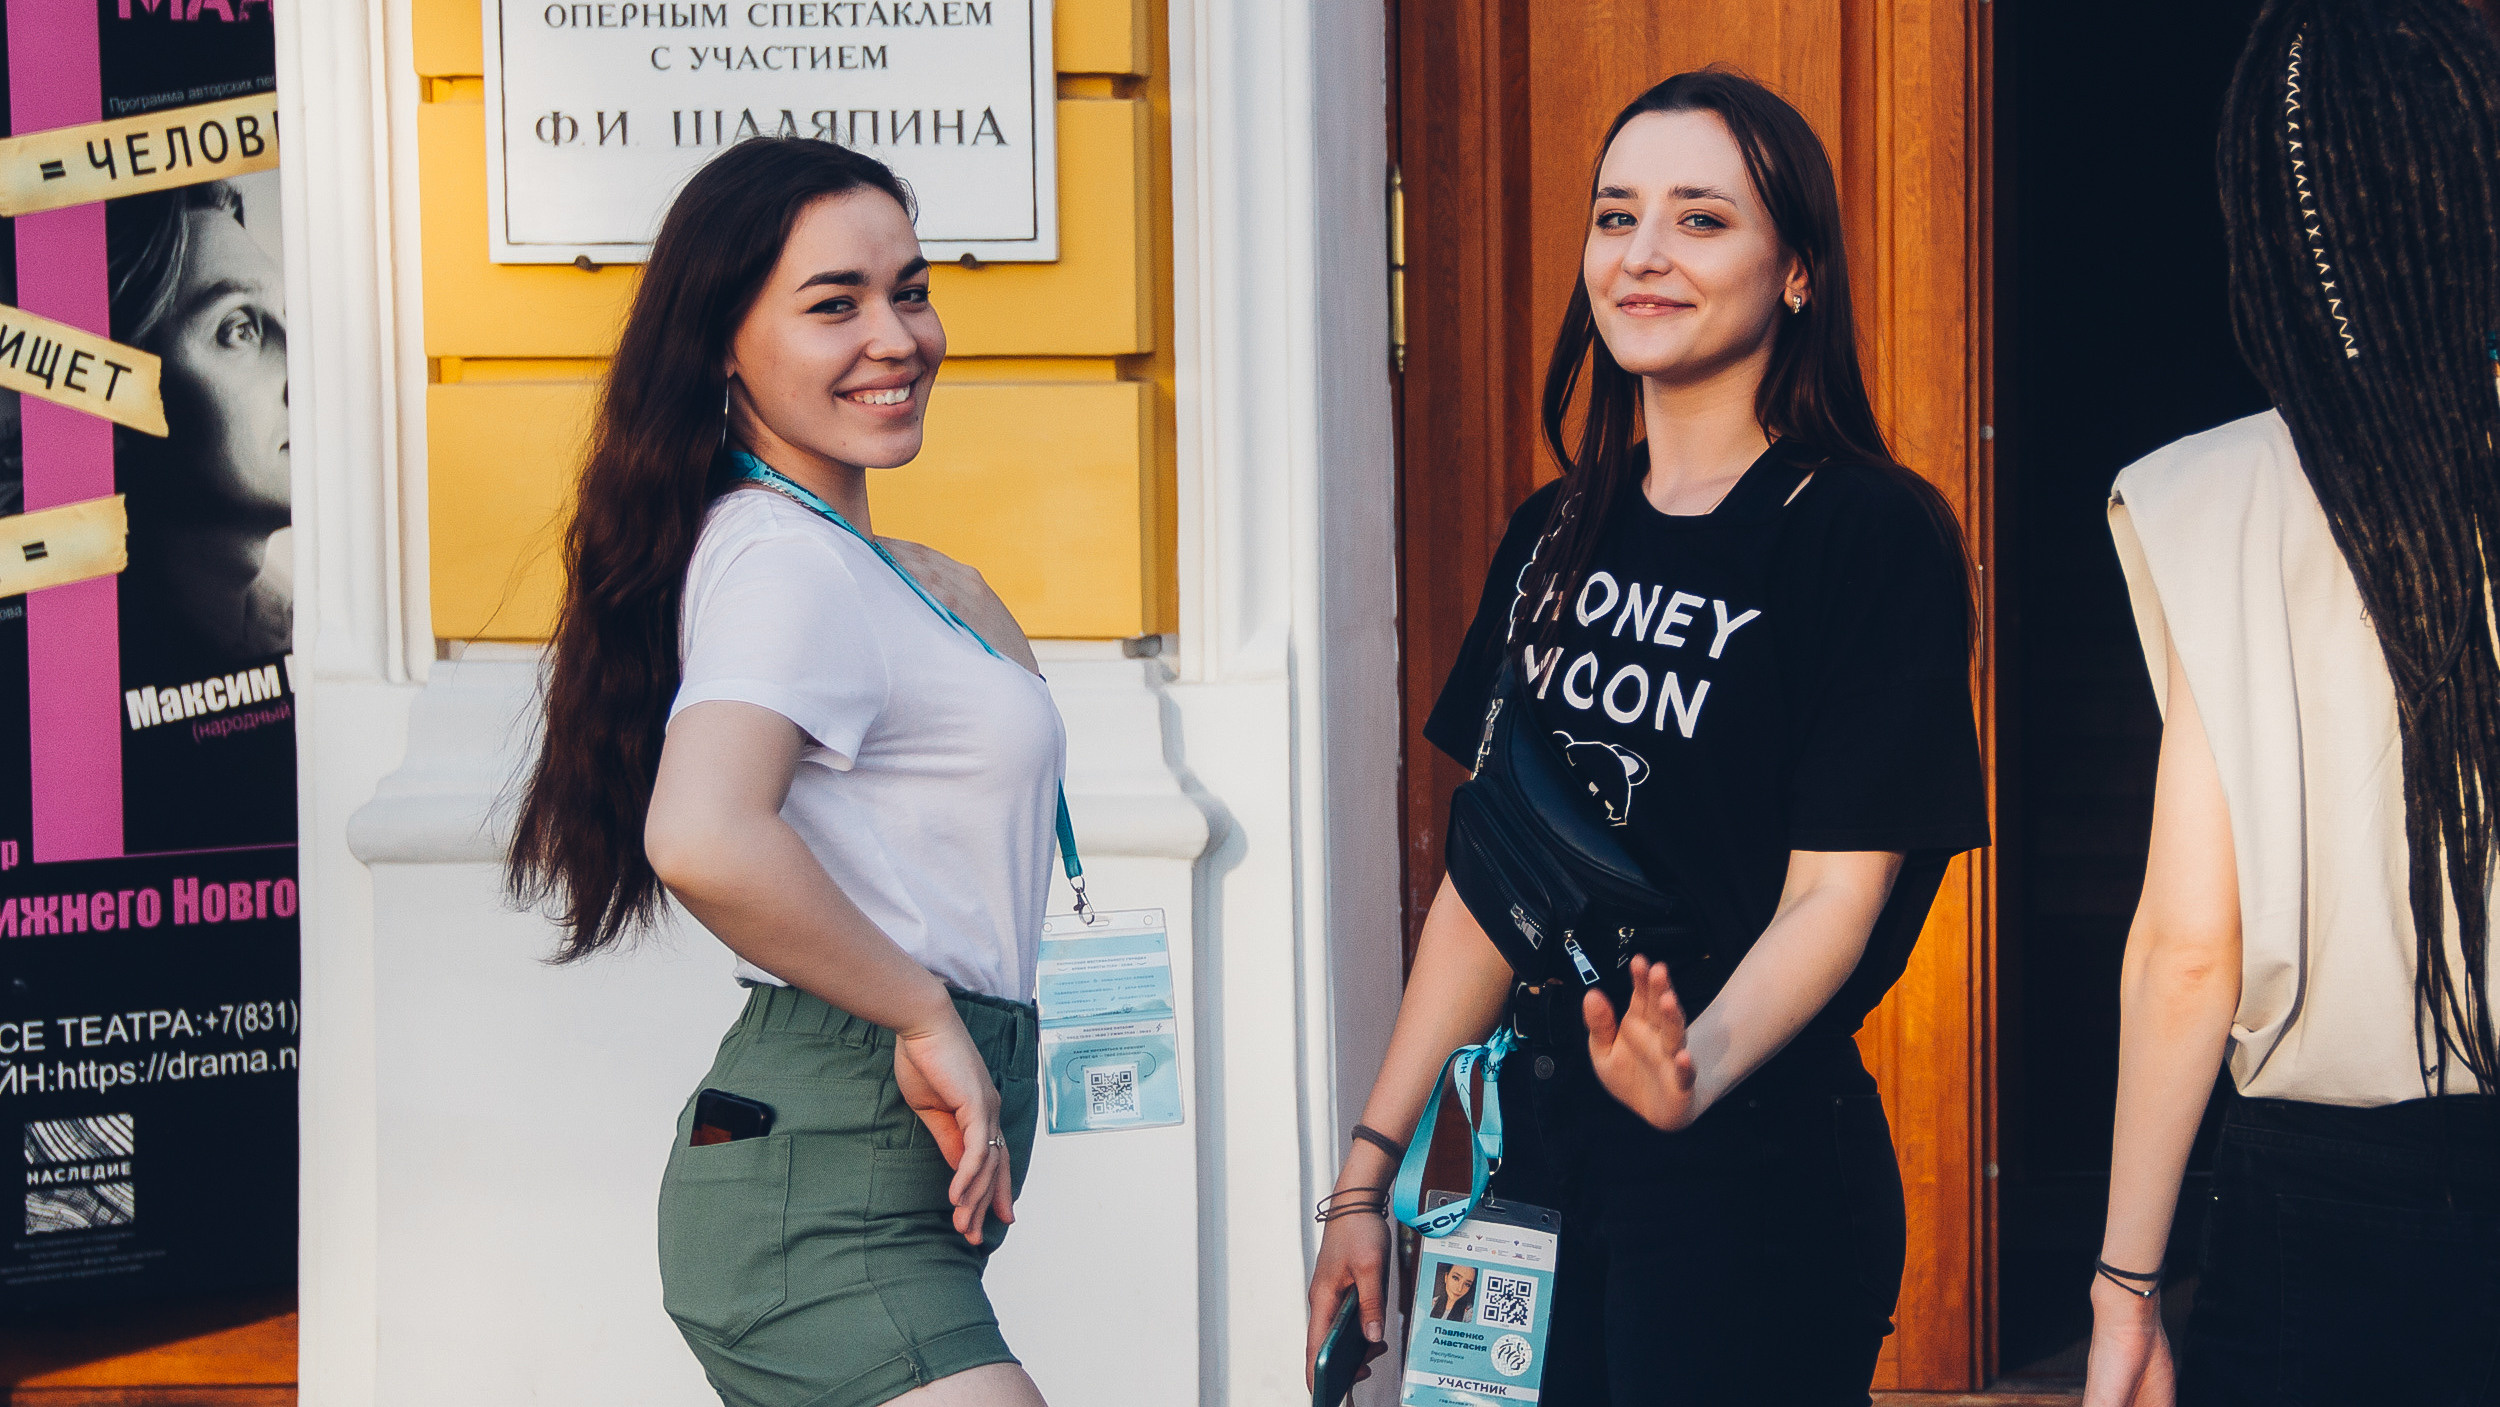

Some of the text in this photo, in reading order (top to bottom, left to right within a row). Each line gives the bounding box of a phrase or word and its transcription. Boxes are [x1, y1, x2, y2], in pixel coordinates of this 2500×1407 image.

[544, 1, 994, 28] ОПЕРНЫМ СПЕКТАКЛЕМ
[651, 43, 889, 71] С УЧАСТИЕМ
[109, 90, 185, 113] Программа
[188, 78, 254, 99] авторских
[125, 665, 282, 730] Максим
[173, 877, 298, 925] Новго
[27, 1161, 132, 1186] НАСЛЕДИЕ
[1432, 1336, 1488, 1353] Анастасия
[1434, 1326, 1485, 1341] Павленко
[1438, 1376, 1508, 1396] УЧАСТНИК
